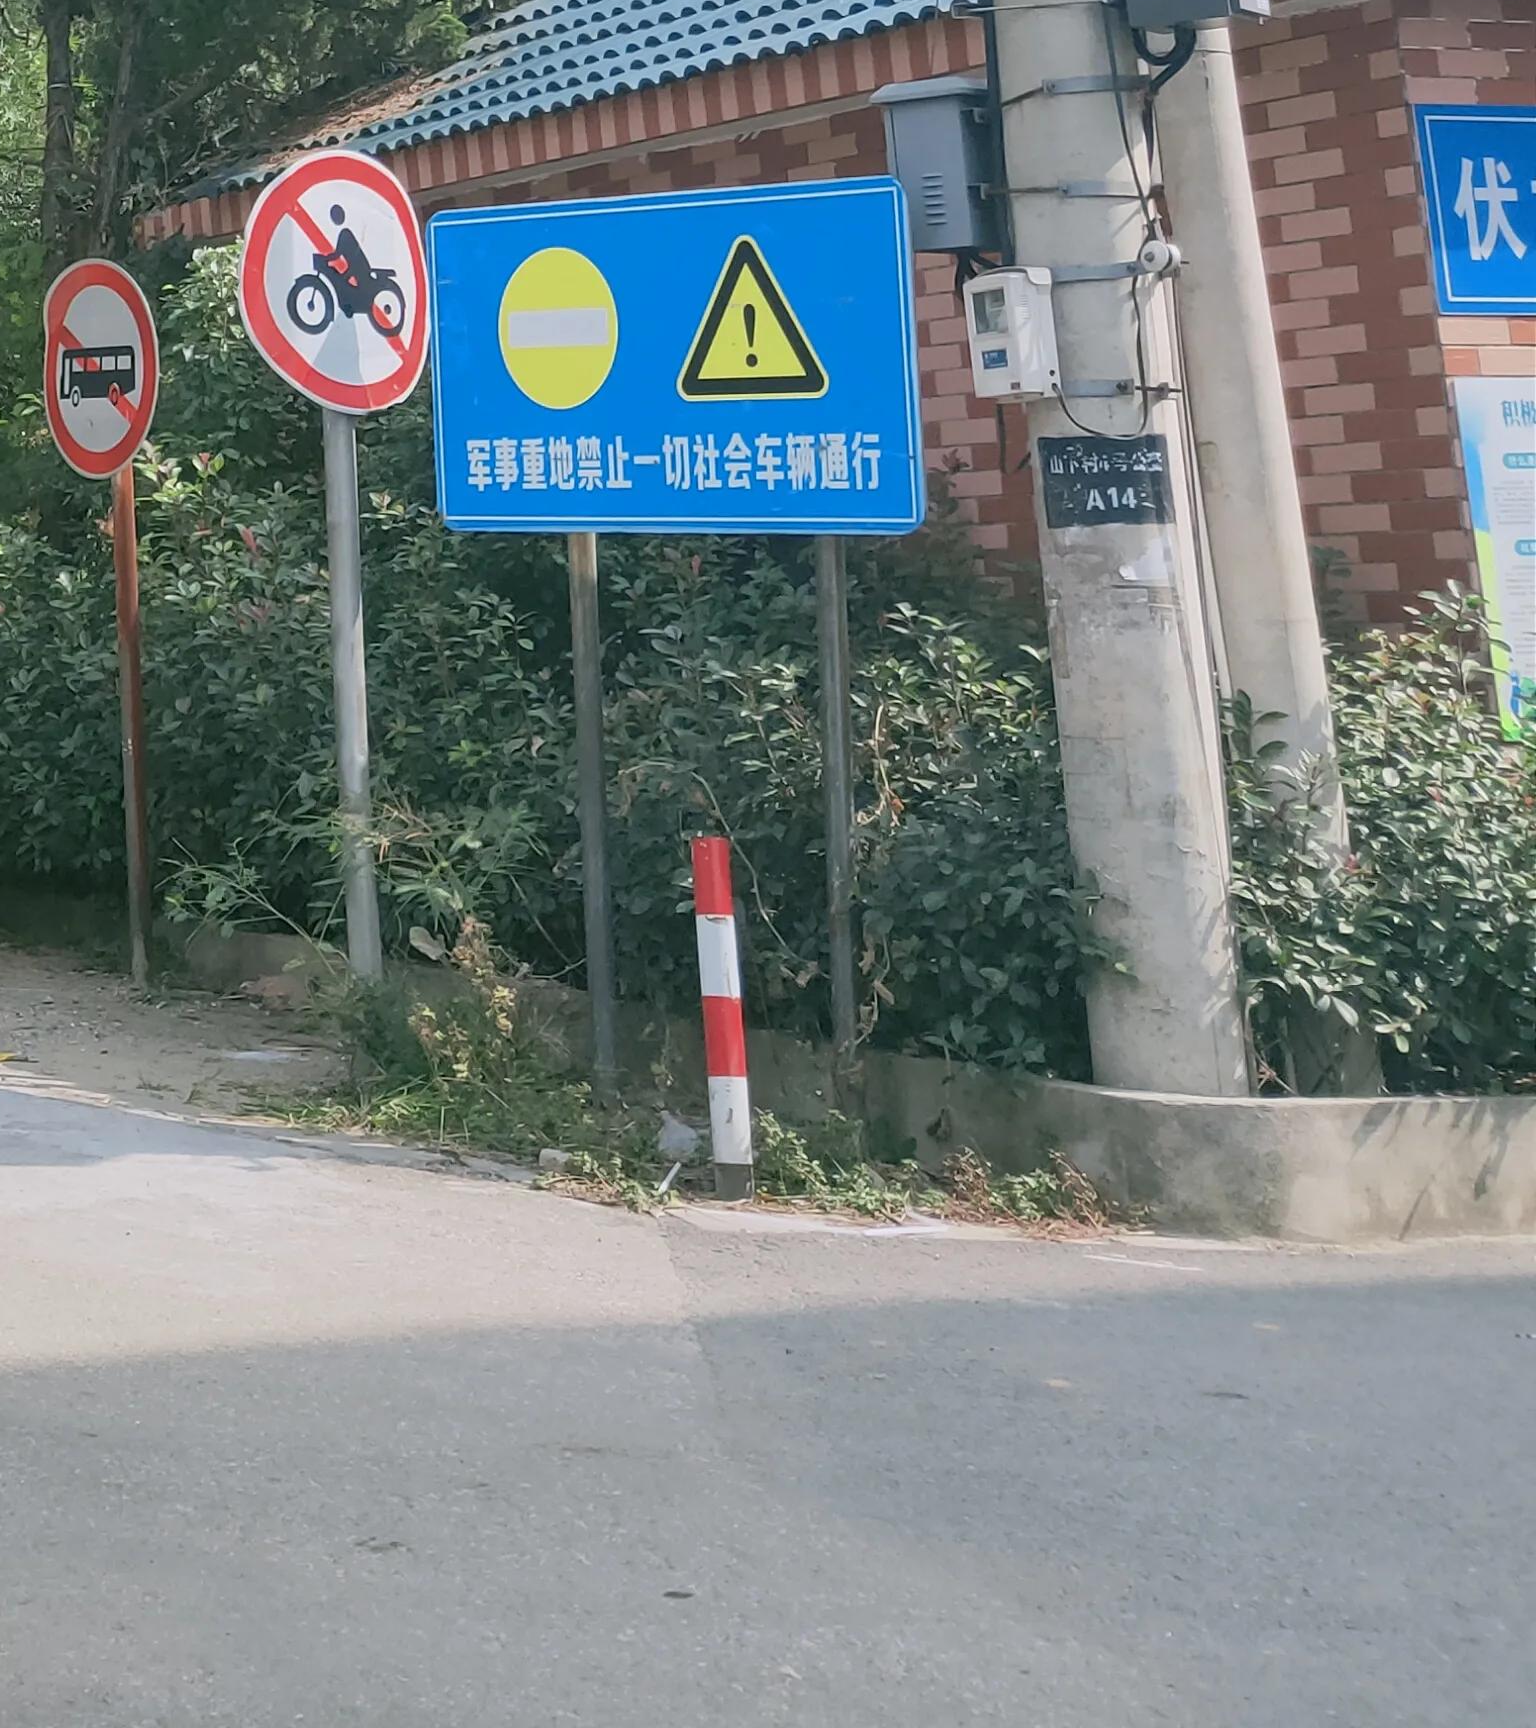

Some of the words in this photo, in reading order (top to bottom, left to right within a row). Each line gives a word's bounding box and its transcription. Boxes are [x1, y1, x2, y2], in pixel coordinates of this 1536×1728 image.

[1453, 156, 1536, 262] 伏
[465, 431, 882, 492] 军事重地禁止一切社会车辆通行
[1085, 486, 1139, 511] A14
